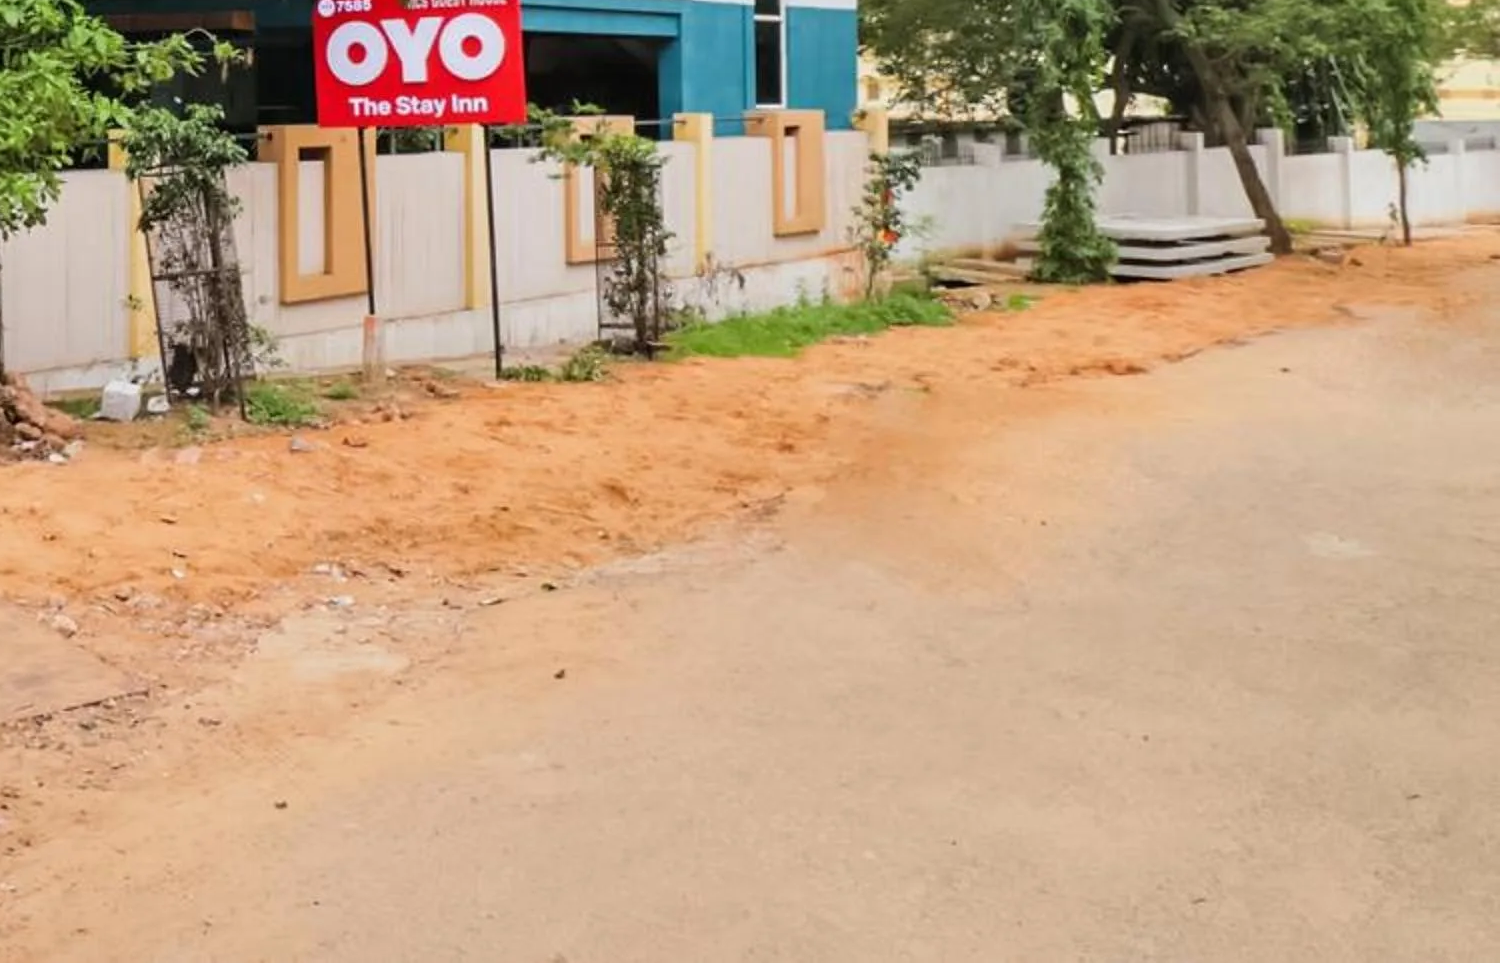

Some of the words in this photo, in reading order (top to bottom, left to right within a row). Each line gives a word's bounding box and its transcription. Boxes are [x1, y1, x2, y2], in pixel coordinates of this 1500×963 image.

[326, 12, 506, 86] OYO
[348, 96, 392, 116] The
[395, 95, 446, 118] Stay
[452, 93, 488, 114] Inn
